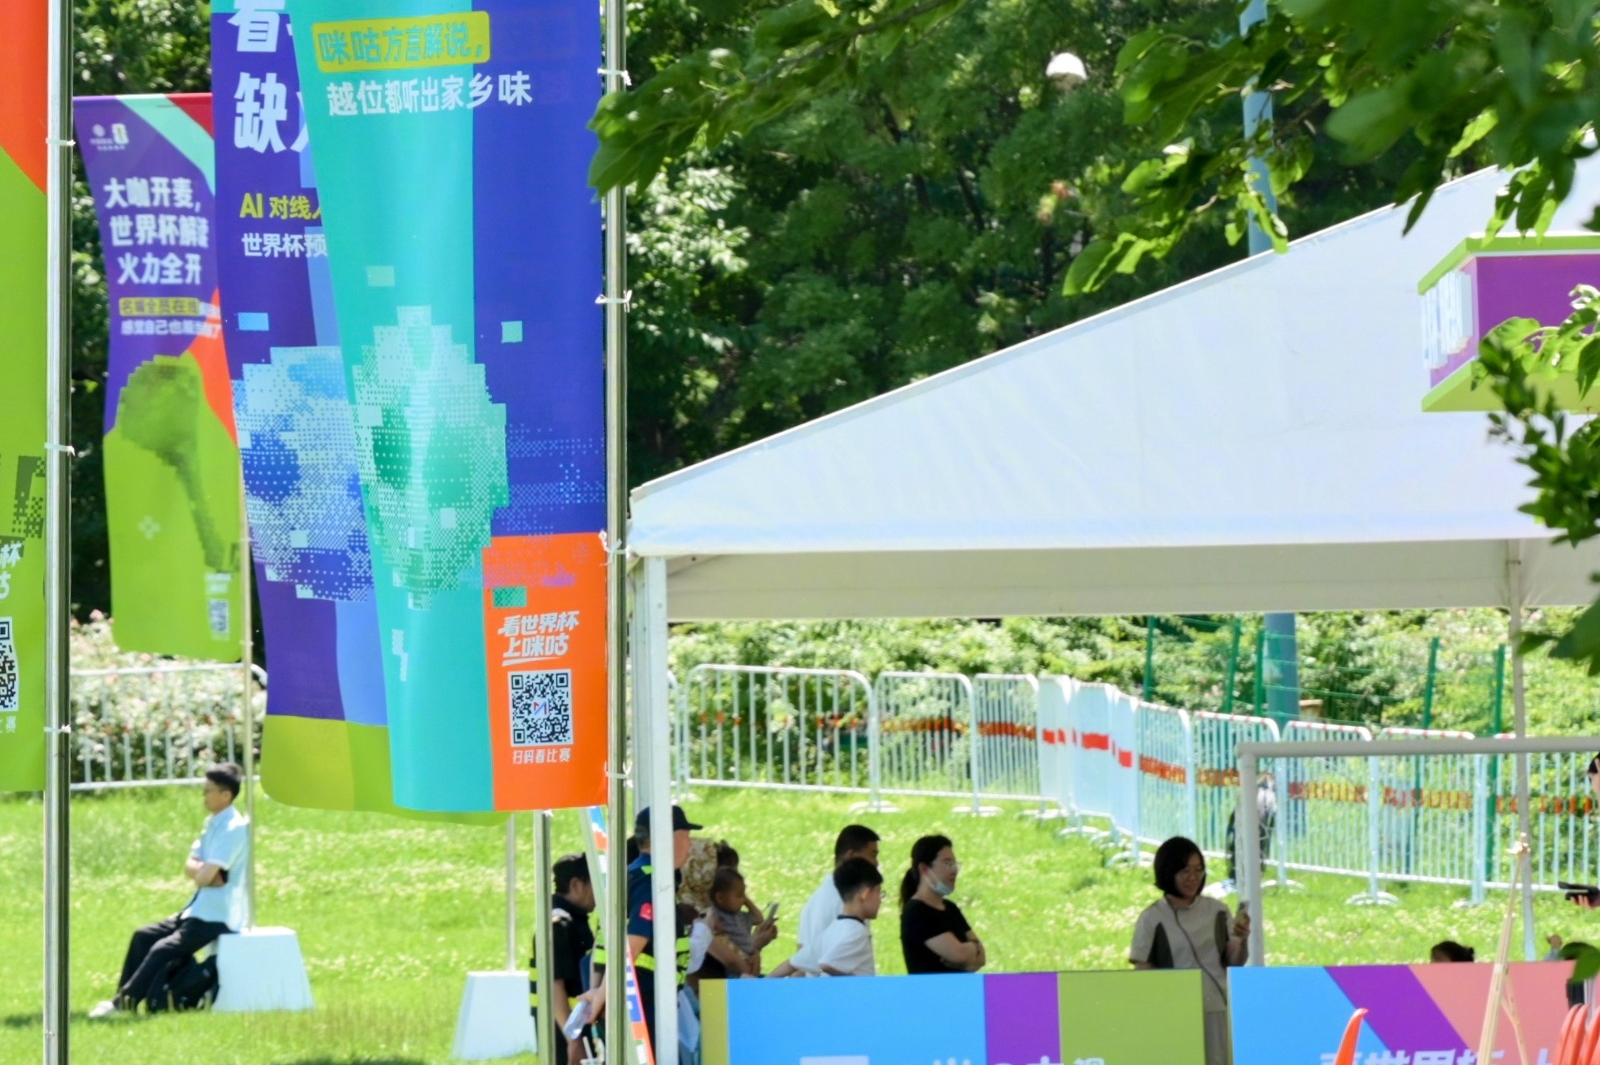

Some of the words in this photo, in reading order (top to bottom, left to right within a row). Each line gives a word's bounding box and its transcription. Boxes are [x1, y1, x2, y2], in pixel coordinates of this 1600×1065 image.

[326, 70, 534, 118] 越位都听出家乡味
[116, 252, 203, 285] 火力全开
[497, 610, 580, 637] 看世界杯
[503, 633, 570, 658] 上咪咕
[512, 747, 572, 765] 扫码看比赛
